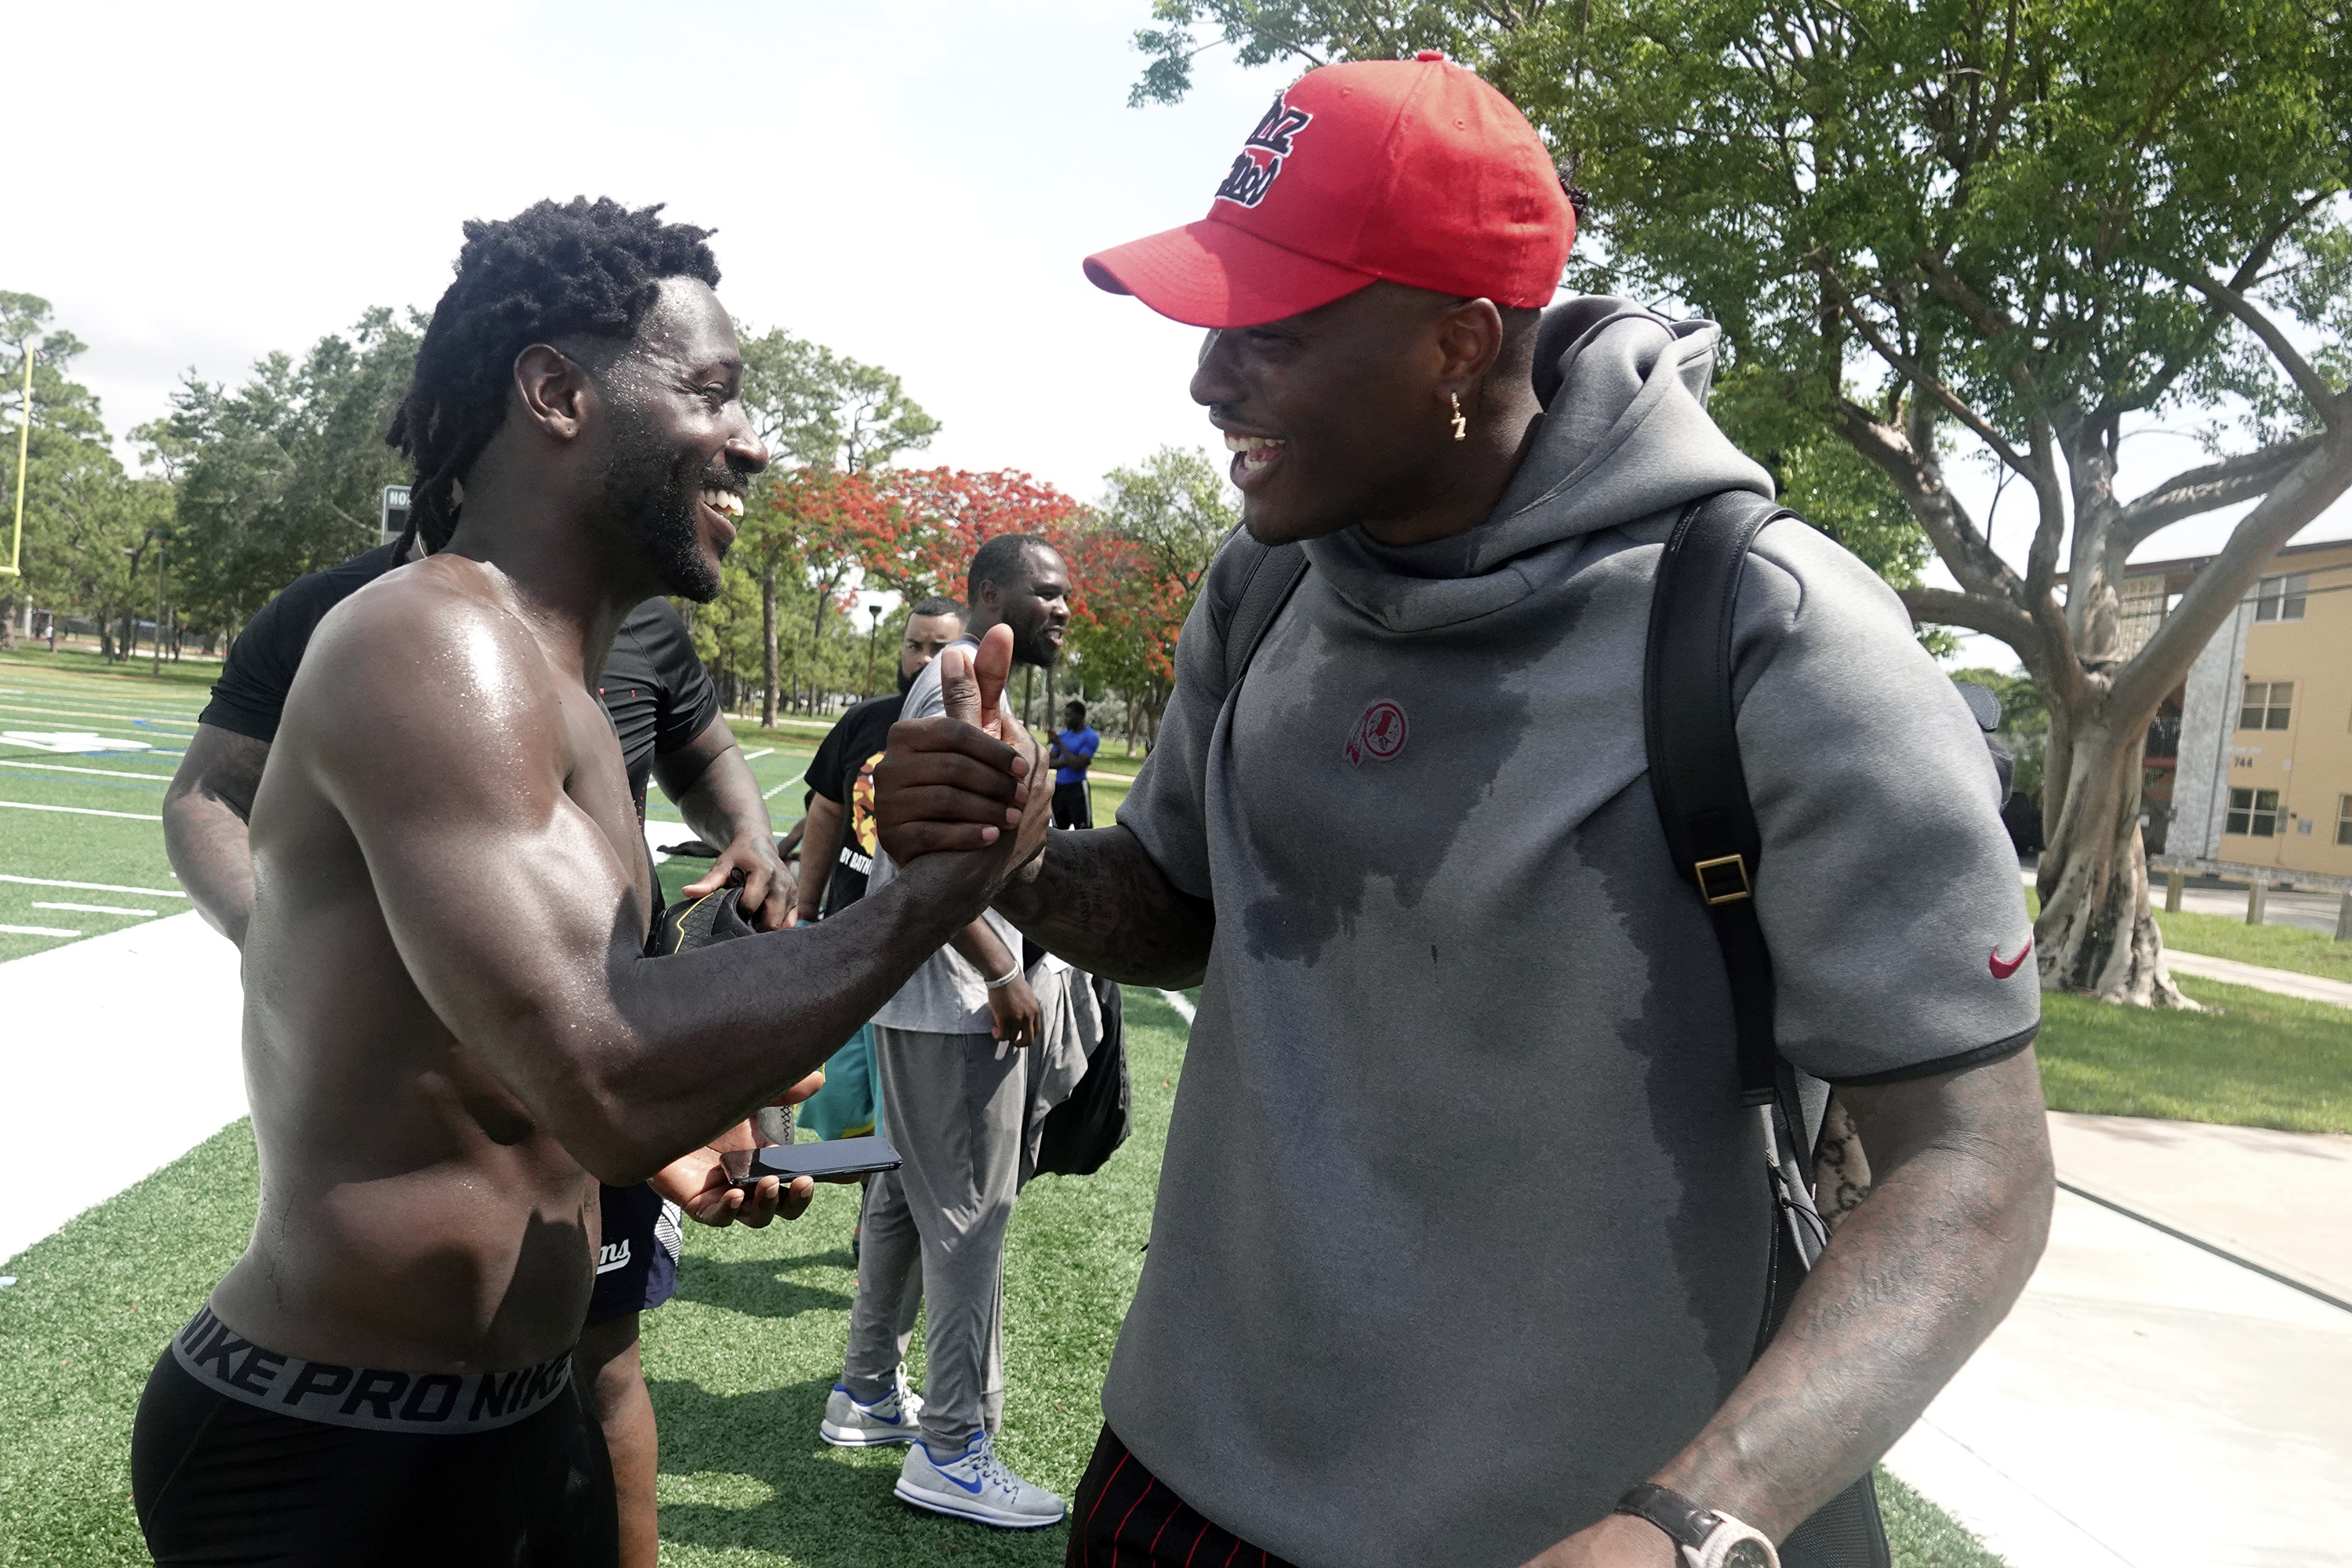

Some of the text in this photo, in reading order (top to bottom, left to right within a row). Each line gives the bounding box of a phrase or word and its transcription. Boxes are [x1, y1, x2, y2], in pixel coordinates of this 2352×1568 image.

[840, 847, 852, 865] BY
[281, 1361, 463, 1422] PRO
[468, 1347, 572, 1421] NIKE
